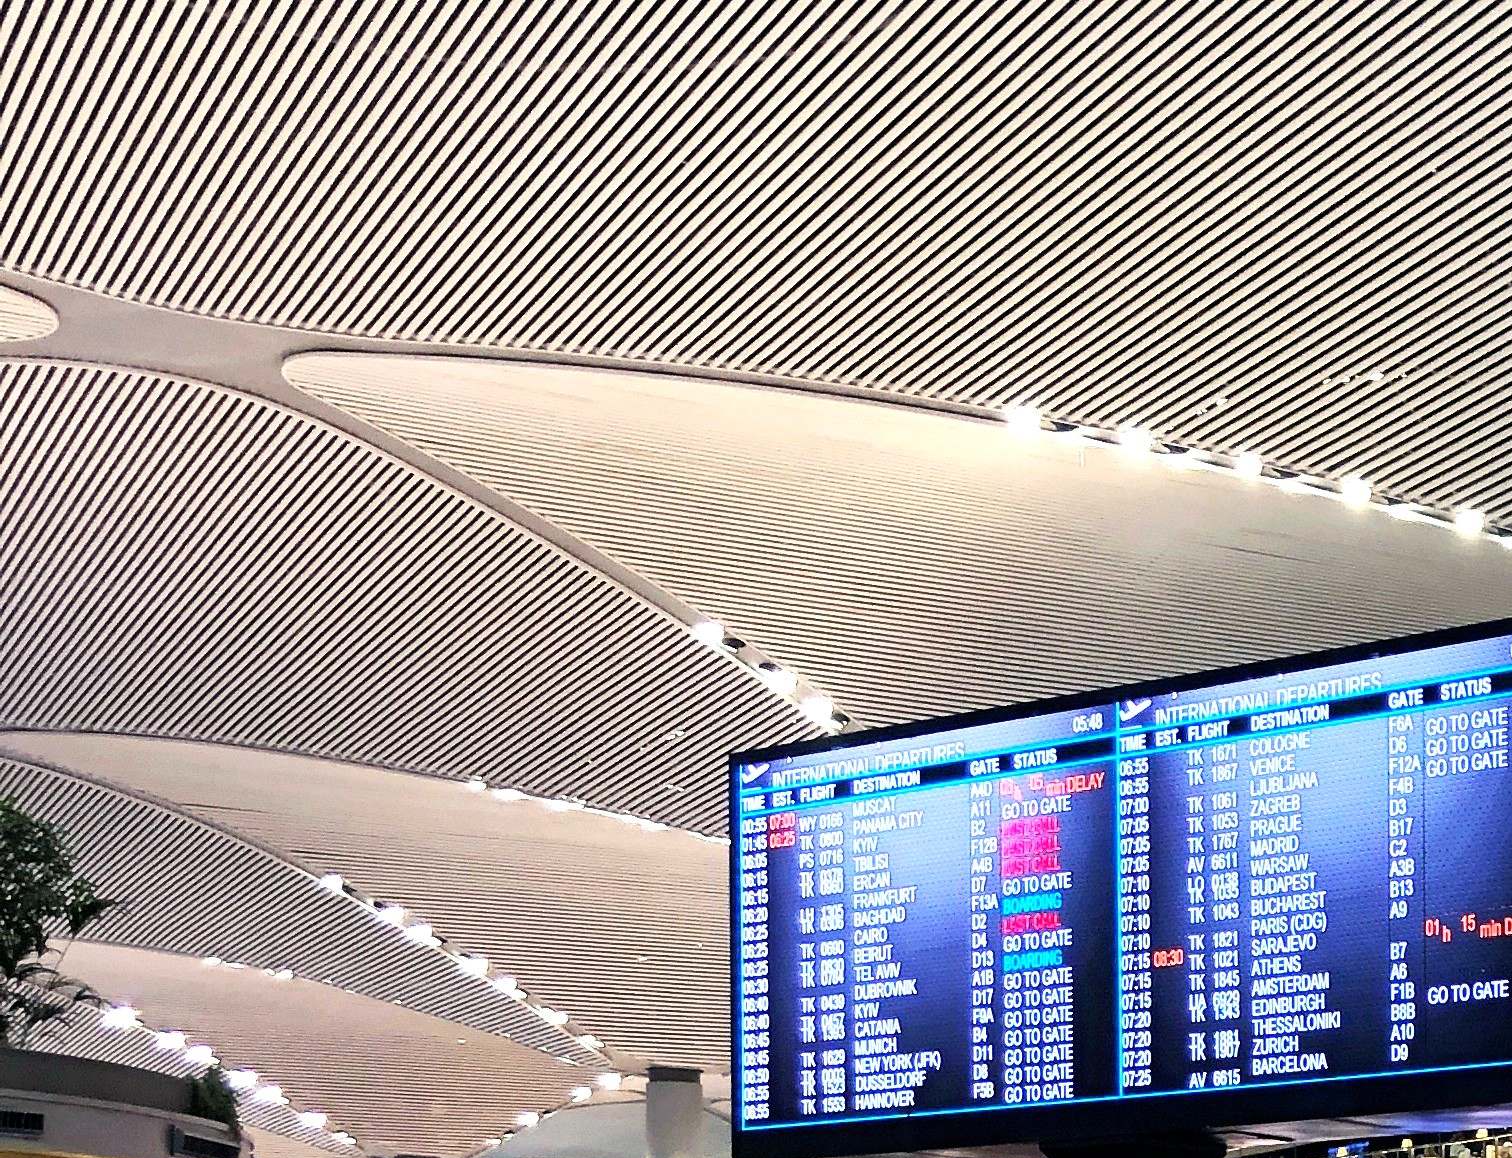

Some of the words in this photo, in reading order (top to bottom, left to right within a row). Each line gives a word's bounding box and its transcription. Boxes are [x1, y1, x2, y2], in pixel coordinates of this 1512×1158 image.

[1155, 696, 1269, 725] INTERNATIONAL
[1276, 672, 1382, 706] DEPARTURES
[1072, 713, 1103, 733] 05:48
[1120, 734, 1146, 752] TIME
[1155, 728, 1181, 746] EST.
[1188, 721, 1230, 742] FLIGHT
[1251, 704, 1330, 731] DESTINATION
[1388, 689, 1424, 709] GATE
[1440, 677, 1492, 701] STATUS
[1250, 731, 1310, 757] COLOGNE
[800, 784, 837, 803] FLIGHT
[853, 771, 921, 794] DESTINATION
[970, 758, 1000, 776] GATE
[1013, 748, 1058, 769] STATUS
[1250, 753, 1296, 776] VENICE
[1250, 772, 1319, 797] LJUBLJANA
[1250, 794, 1301, 817] ZAGREB
[1389, 798, 1407, 816] D3
[1250, 814, 1302, 837] PRAGUE
[1389, 818, 1414, 837] B17
[1250, 835, 1299, 857] MADRID
[853, 854, 889, 872] TBILISI
[1250, 853, 1310, 877] WARSAW
[853, 872, 891, 891] ERCAN
[1250, 873, 1318, 896] BUDAPEST
[1389, 879, 1414, 898] B13
[853, 886, 917, 909] FRANKFURT
[1250, 891, 1326, 917] BUCHAREST
[854, 907, 906, 927] BAGHDAD
[1389, 900, 1408, 919] A9
[1251, 918, 1288, 936] PARIS
[1290, 912, 1327, 934] (CDG)
[1460, 913, 1476, 932] 15
[1479, 920, 1501, 938] min
[854, 927, 888, 945] CAIRO
[1251, 932, 1317, 957] SARAJEVO
[854, 944, 893, 964] BEIRUT
[1390, 941, 1408, 960] B7
[1251, 955, 1301, 977] ATHENS
[1251, 972, 1330, 997] AMSTERDAM
[1391, 982, 1415, 1001] F1B
[1427, 986, 1449, 1005] GO
[1451, 984, 1470, 1003] TO
[1473, 979, 1510, 1001] GATE
[1252, 993, 1325, 1017] EDINBURGH
[1252, 1011, 1341, 1036] THESSALONIKI
[1390, 1023, 1415, 1042] A10
[1252, 1035, 1299, 1056] ZURICH
[1391, 1044, 1409, 1062] D9
[1252, 1052, 1328, 1076] BARCELONA
[855, 1070, 926, 1092] DUSSELDORF
[855, 1090, 915, 1110] HANNOVER
